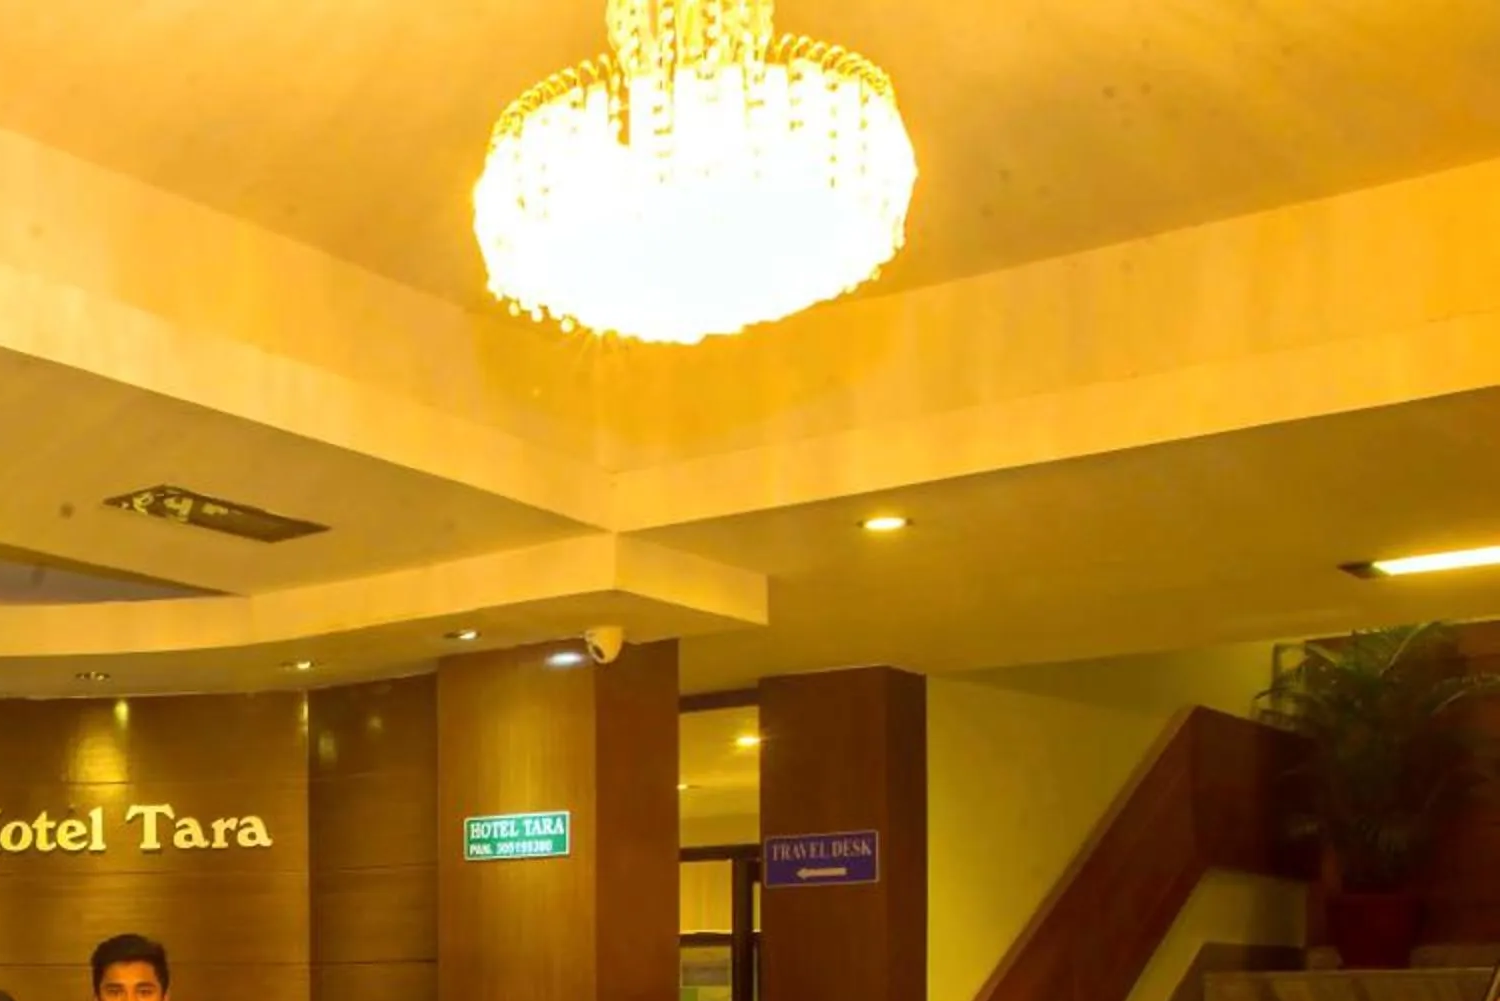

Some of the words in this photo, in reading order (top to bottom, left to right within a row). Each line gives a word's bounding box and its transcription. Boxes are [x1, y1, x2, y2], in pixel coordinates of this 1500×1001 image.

[125, 803, 272, 849] Tara
[470, 820, 519, 839] HOTEL
[523, 817, 564, 836] TARA
[771, 841, 825, 861] TRAVEL
[831, 837, 872, 857] DESK
